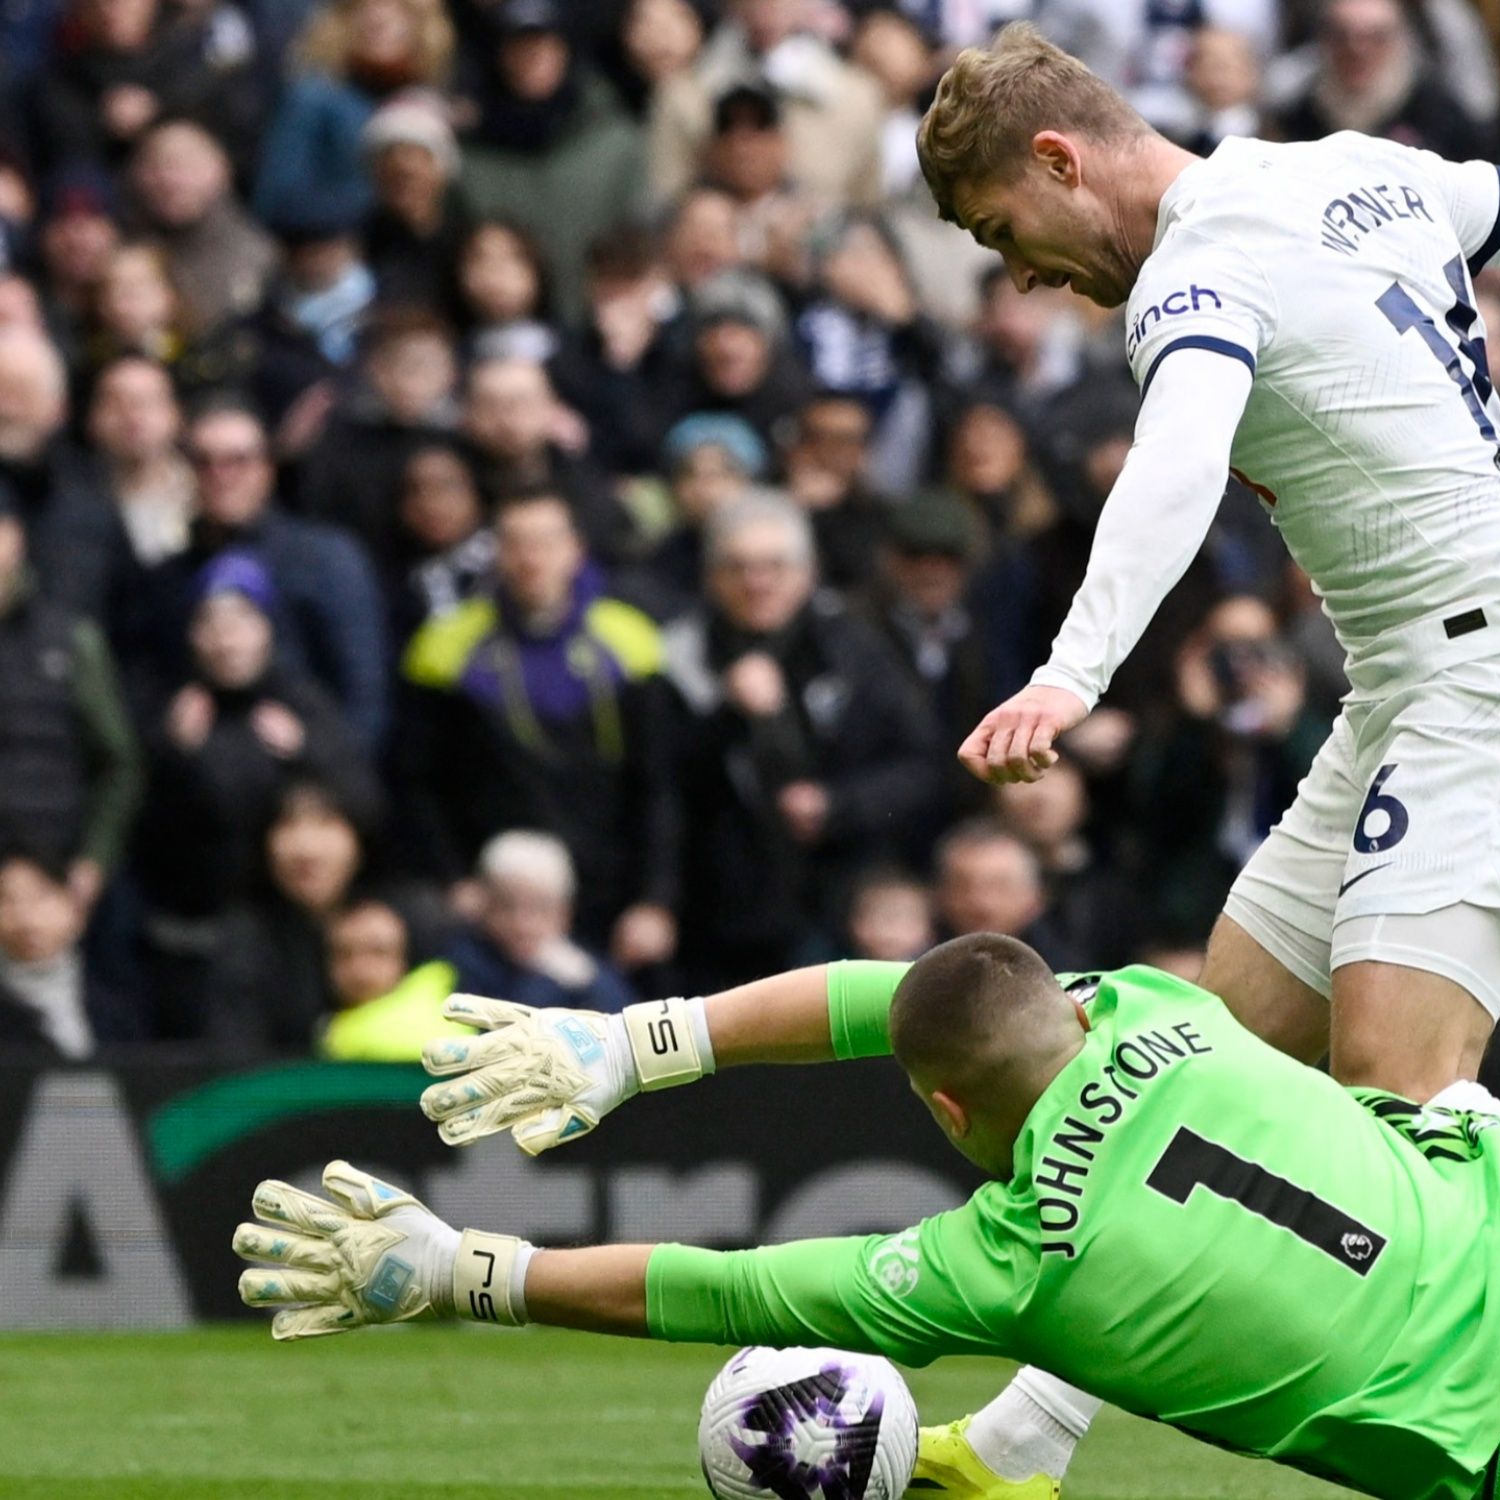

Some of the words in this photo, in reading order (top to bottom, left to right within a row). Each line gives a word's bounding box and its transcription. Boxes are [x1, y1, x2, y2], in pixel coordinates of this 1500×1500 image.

[1128, 284, 1222, 362] cinch
[1035, 1022, 1213, 1259] JOHNSTONE
[1145, 1125, 1388, 1278] 1
